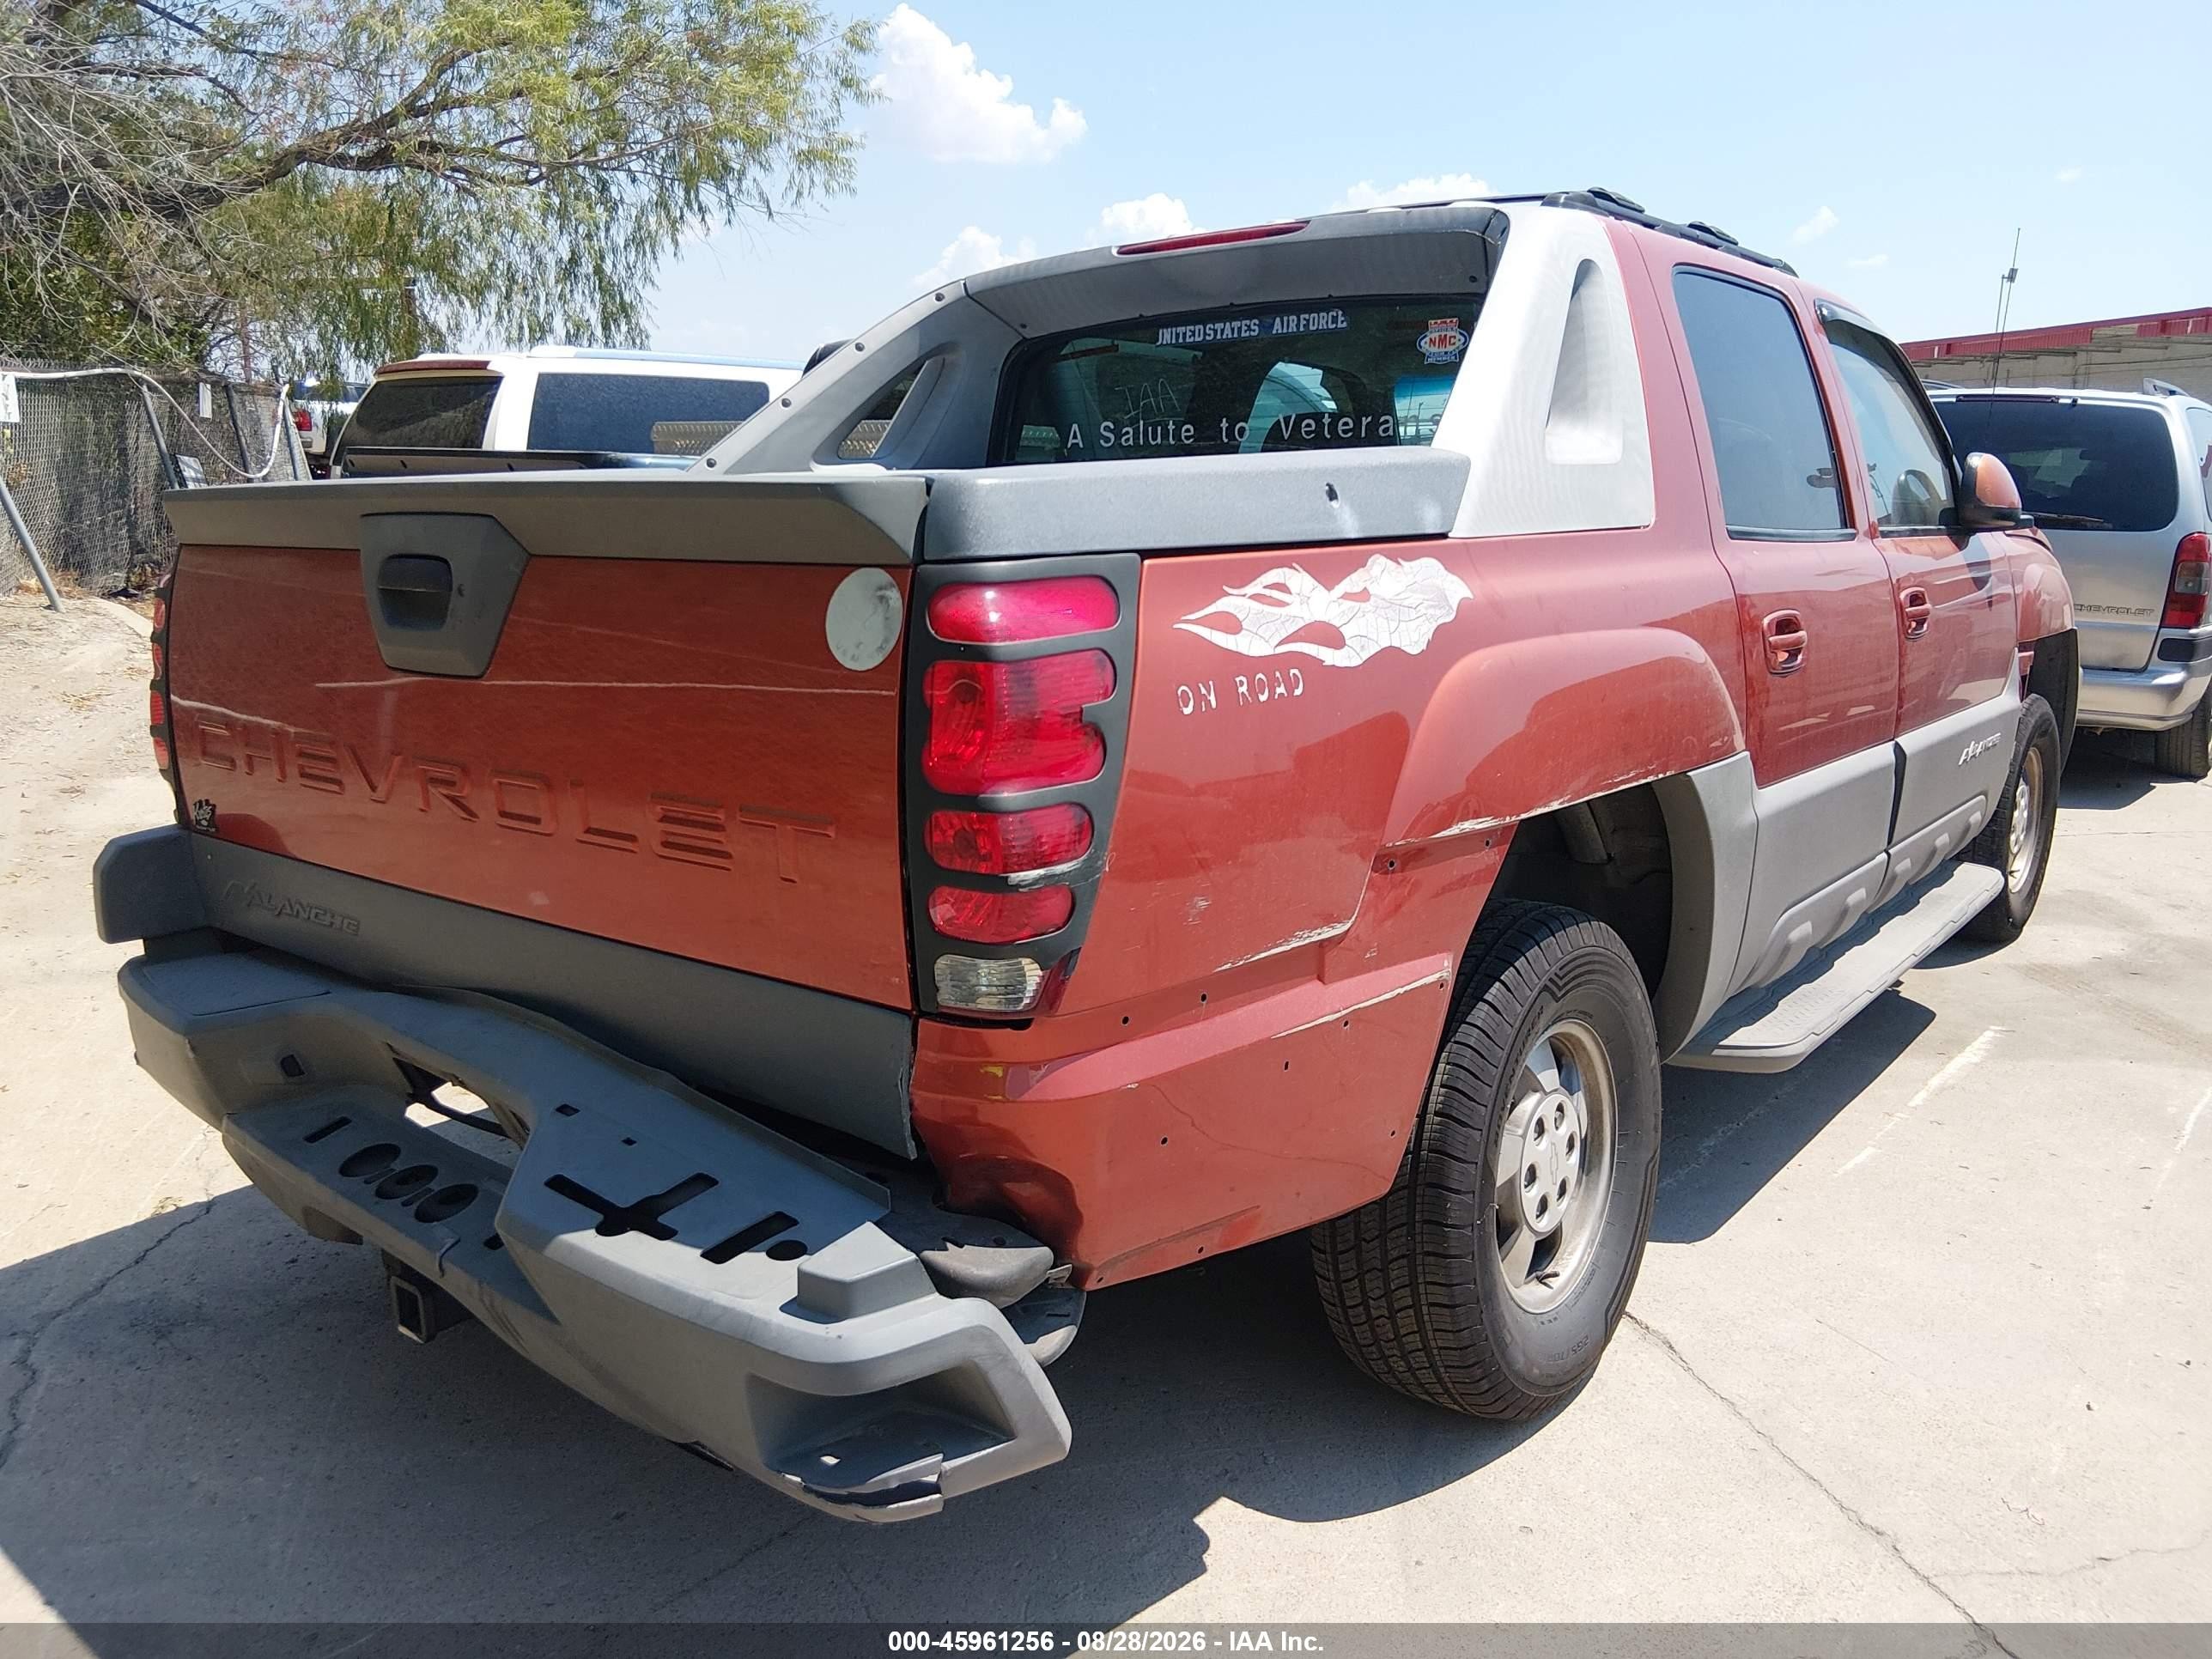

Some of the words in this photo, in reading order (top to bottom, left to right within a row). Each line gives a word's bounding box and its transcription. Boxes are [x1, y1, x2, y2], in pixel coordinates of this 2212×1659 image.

[1206, 319, 1260, 340] STATES
[1272, 315, 1298, 335] AIR
[1299, 309, 1347, 332] FORCE
[1429, 333, 1457, 349] NMC
[1115, 379, 1182, 419] IAA
[1067, 423, 1085, 448] A
[1100, 419, 1195, 447] Salute
[1220, 417, 1250, 443] to
[1177, 681, 1218, 715] ON
[1235, 668, 1305, 706] ROAD
[196, 716, 836, 884] CHEVROLET
